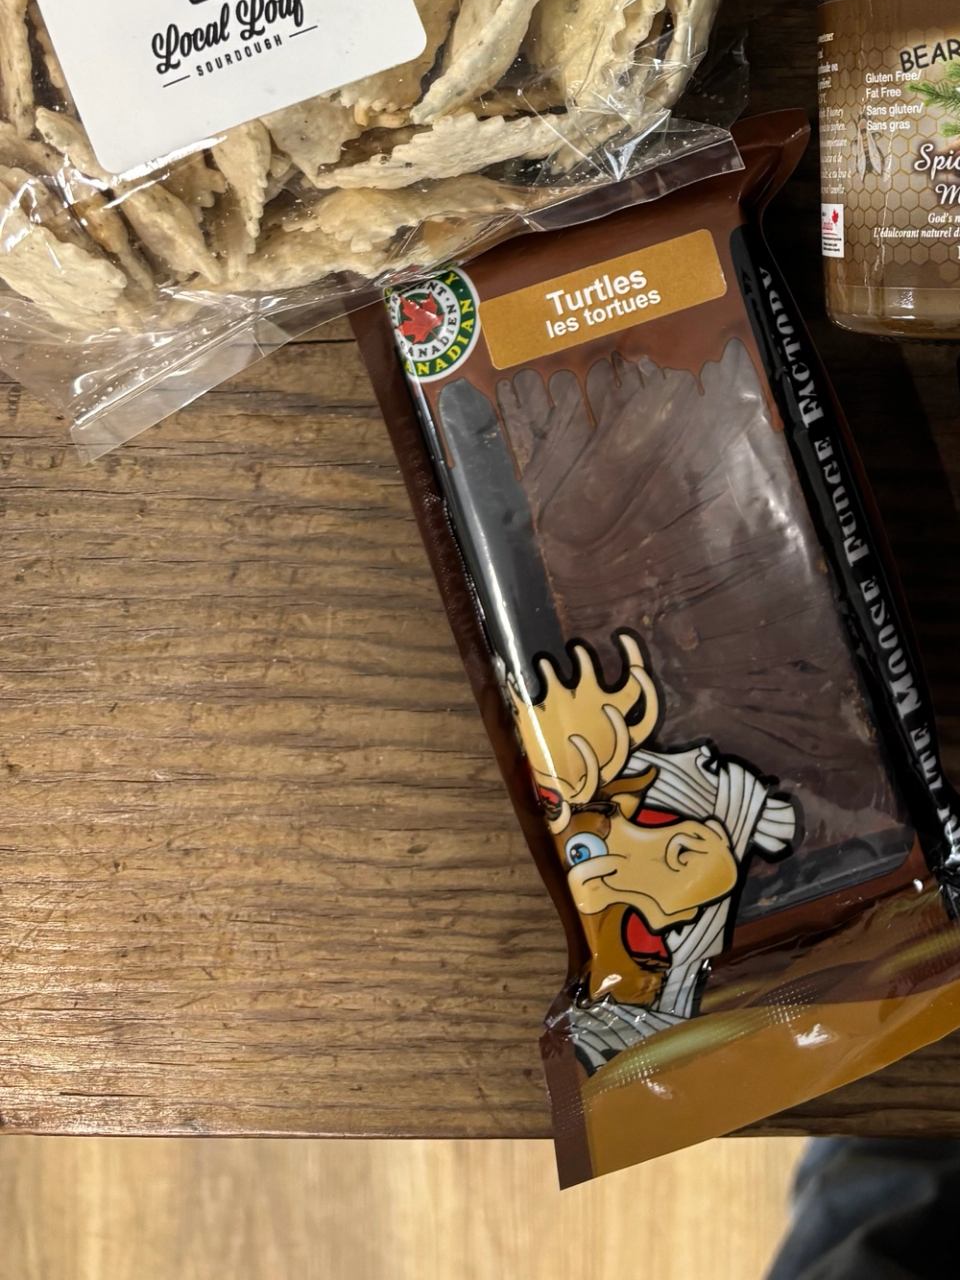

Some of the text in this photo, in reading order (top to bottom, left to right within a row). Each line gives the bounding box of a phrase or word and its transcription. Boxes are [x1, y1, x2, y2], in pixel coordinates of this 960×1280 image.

[151, 1, 230, 75] Local
[196, 33, 283, 77] SOURDOUGH
[865, 72, 894, 84] Gluten
[866, 86, 902, 98] Fat Free
[866, 105, 887, 116] Sans
[866, 120, 911, 133] Sans gras
[873, 226, 919, 238] L'édulcorant
[920, 226, 952, 238] naturel
[927, 211, 953, 224] God's
[545, 267, 649, 316] Turtles
[545, 288, 662, 340] les tortues
[403, 299, 475, 375] ANADIAN
[814, 435, 870, 567] FUDGE
[860, 574, 922, 720] MOOSE
